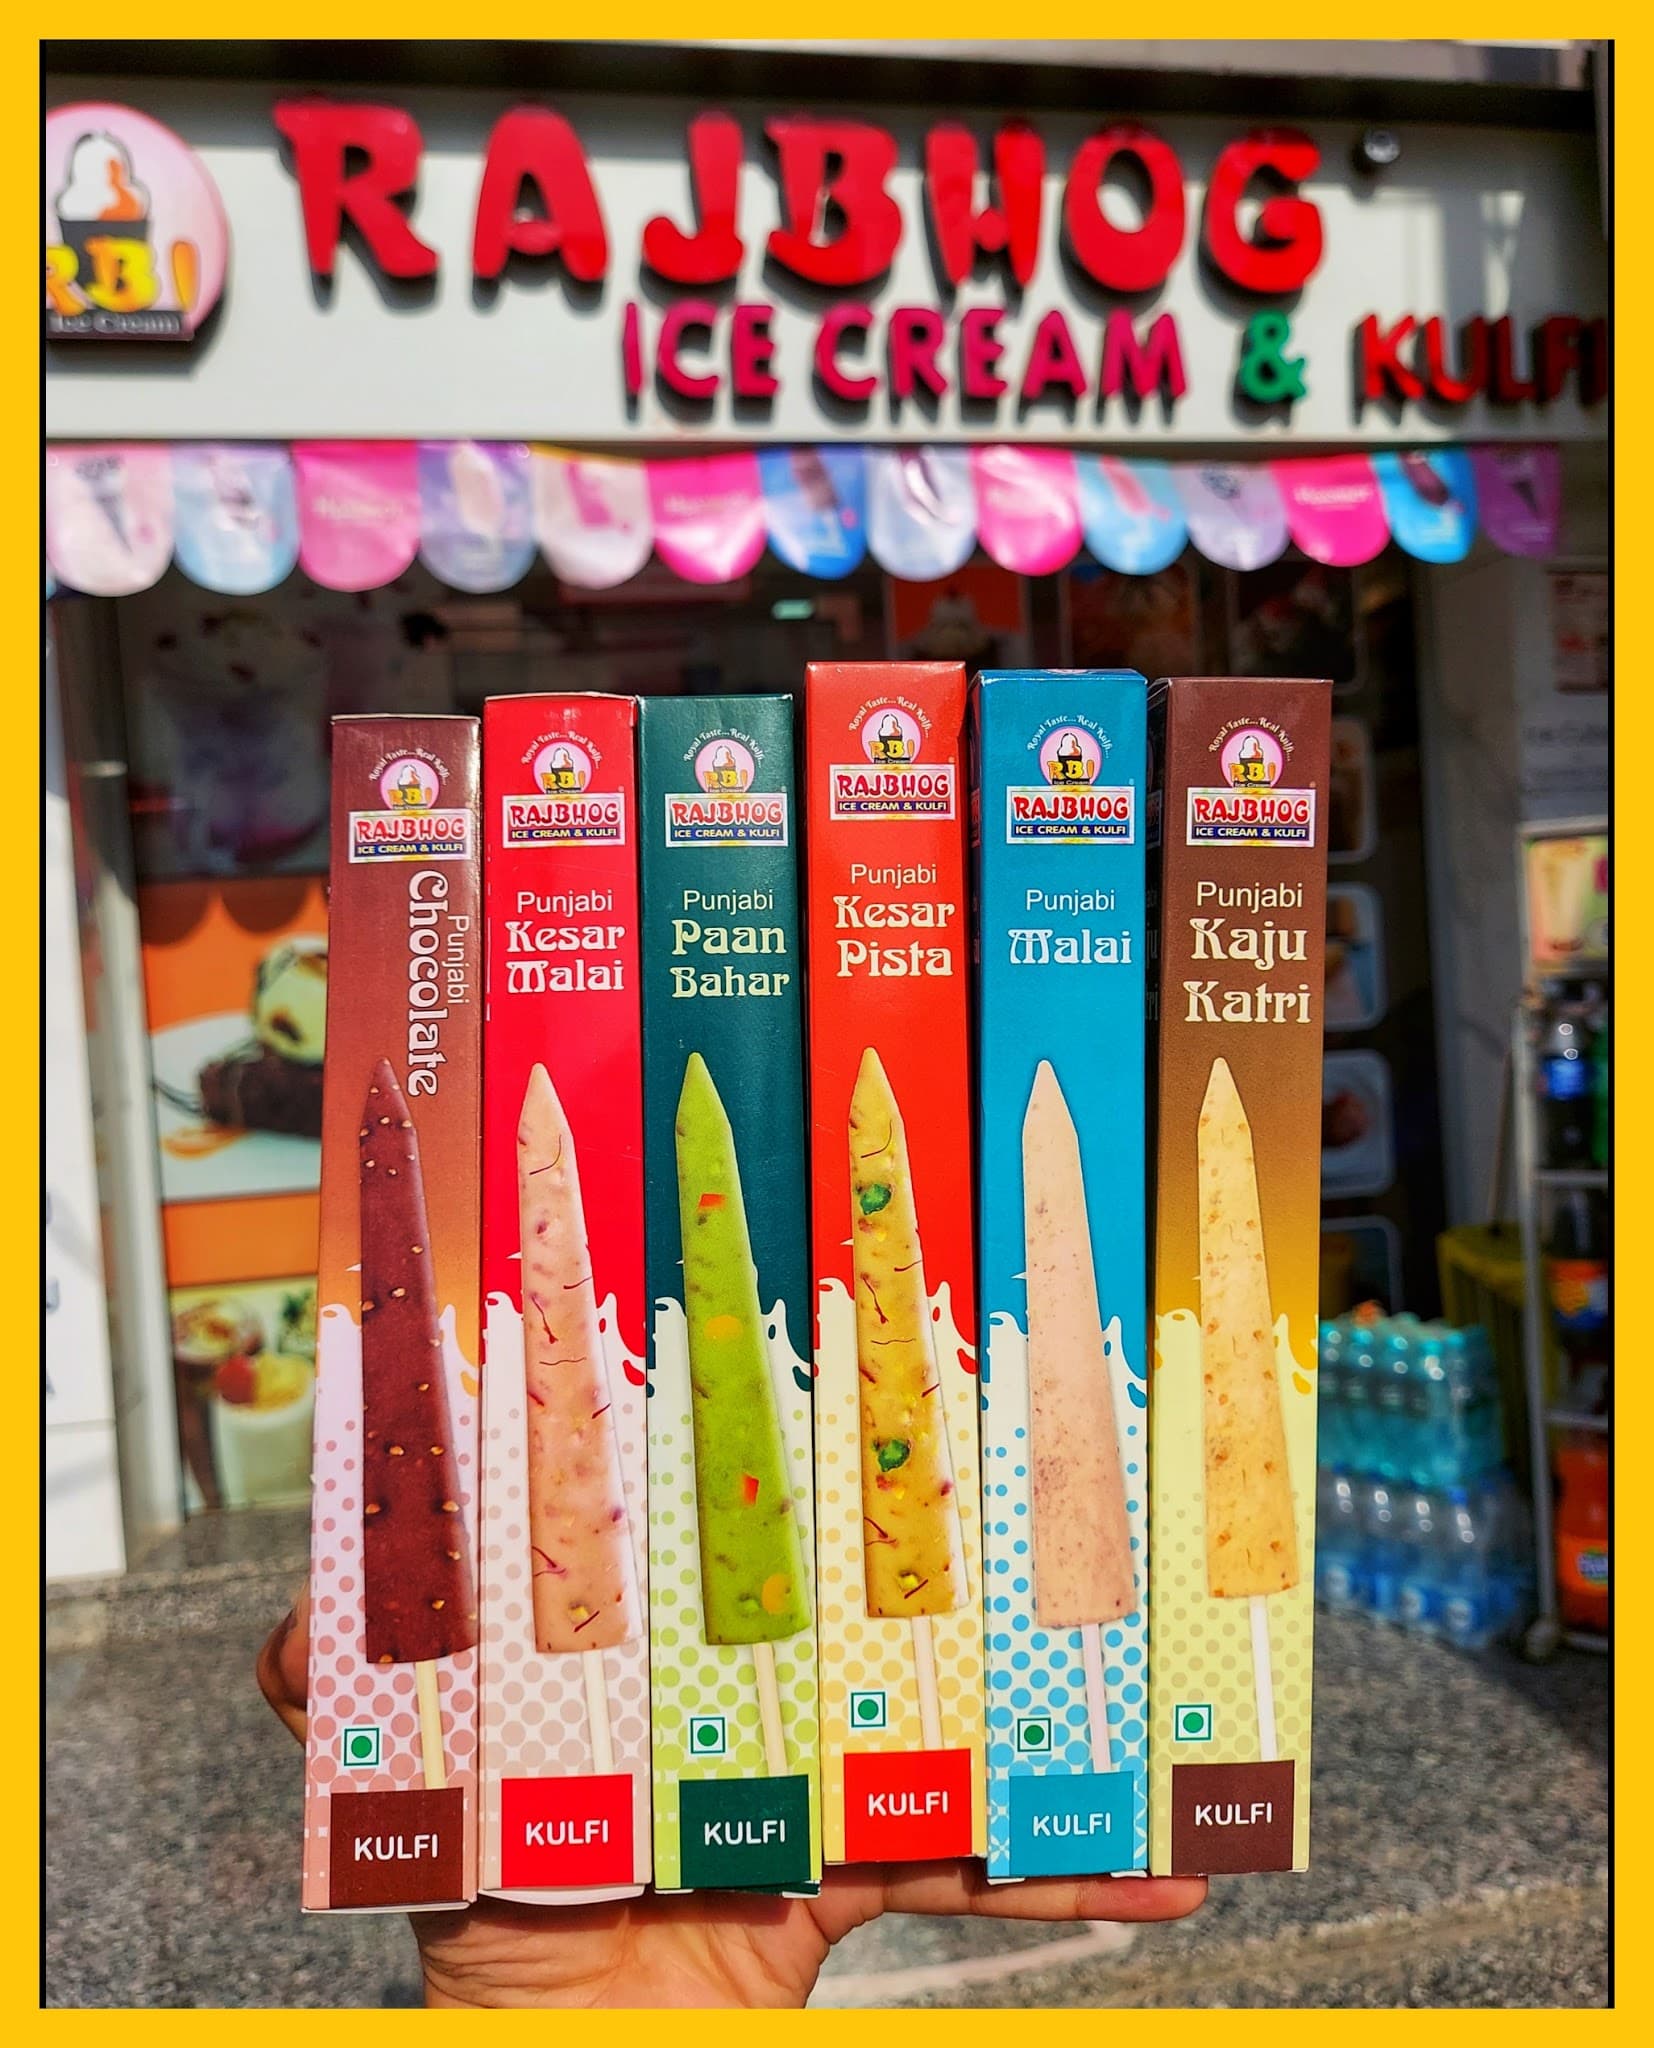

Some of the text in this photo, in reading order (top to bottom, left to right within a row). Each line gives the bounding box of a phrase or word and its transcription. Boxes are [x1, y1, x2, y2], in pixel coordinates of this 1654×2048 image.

[273, 98, 1324, 292] RAJBHOG
[622, 302, 1608, 402] ICE CREAM & KULFI
[837, 774, 949, 797] RAJBHOG
[510, 803, 618, 825] RAJBHOG
[672, 802, 782, 824] RAJBHOG
[839, 801, 947, 811] ICE CREAM & KULFI
[1013, 796, 1128, 820] RAJBHOG
[1194, 798, 1309, 823] RAJBHOG
[356, 818, 466, 841] RAJBHOG
[512, 828, 617, 838] ICE CREAM & KULFI
[674, 828, 780, 838] ICE CREAM & KULFI
[1015, 826, 1126, 834] ICE CREAM & KULFI
[1196, 827, 1306, 837] ICE CREAM & KULFI
[358, 843, 463, 854] ICE CREAM & KULFI
[850, 863, 937, 889] Punjabi
[516, 889, 614, 918] Punjabi
[683, 889, 773, 915] Punjabi
[1025, 889, 1116, 916] Punjabi
[1196, 881, 1303, 914] Punjabi
[832, 895, 956, 929] Kesar
[504, 920, 626, 952] Kesar
[671, 919, 787, 955] Paan
[1007, 928, 1132, 964] Malai
[1188, 917, 1309, 971] Kaju
[442, 914, 471, 1005] Punjabi
[835, 939, 953, 978] Pista
[407, 869, 449, 1097] Chocolate
[505, 959, 625, 993] Malai
[669, 966, 790, 998] Bahar
[1183, 980, 1312, 1023] Katri
[867, 1791, 949, 1817] KULFI
[1194, 1802, 1273, 1827] KULFI
[524, 1819, 610, 1847] KULFI
[703, 1819, 787, 1846] KULFI
[1032, 1812, 1111, 1837] KULFI
[353, 1834, 439, 1862] KULFI
